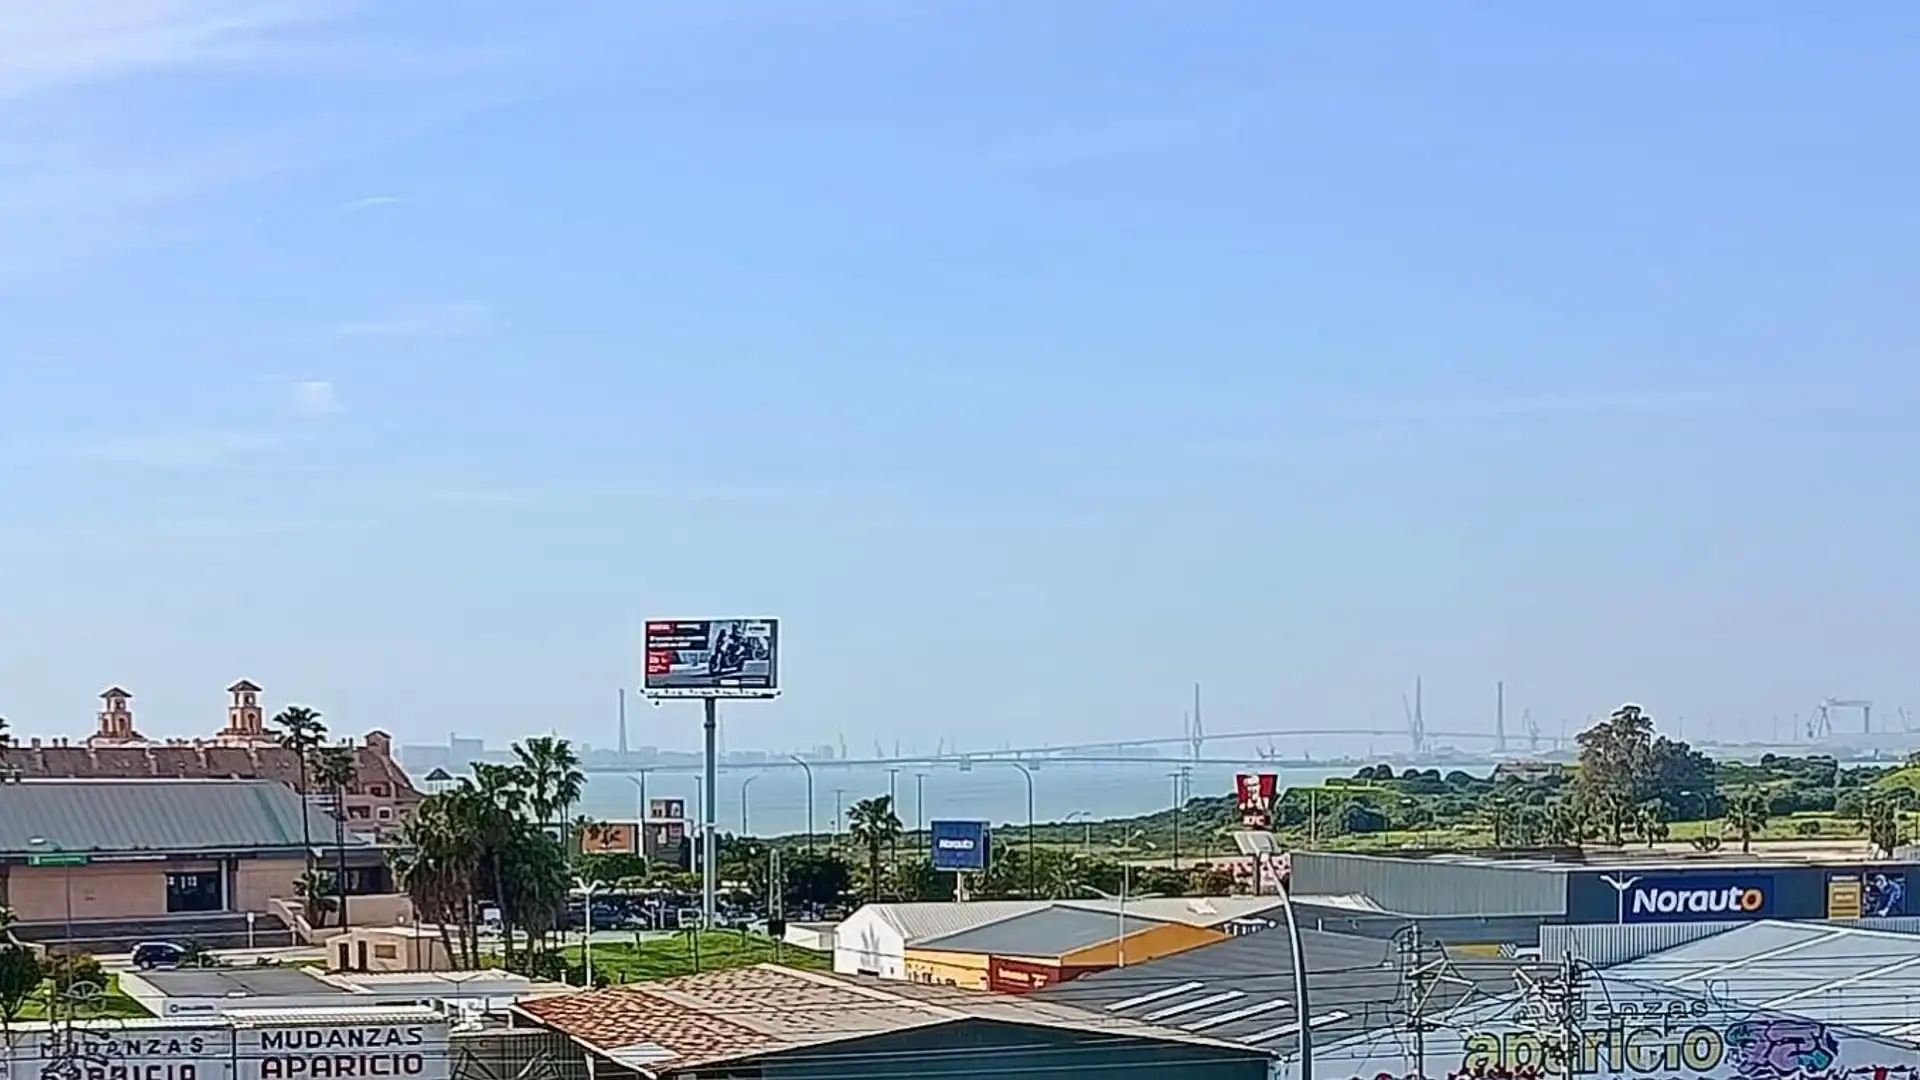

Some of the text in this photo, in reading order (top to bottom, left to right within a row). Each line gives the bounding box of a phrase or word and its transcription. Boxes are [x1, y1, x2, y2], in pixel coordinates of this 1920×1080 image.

[1632, 886, 1763, 913] Norauto
[261, 1027, 424, 1049] MUDANZAS
[261, 1053, 424, 1079] APARICIO
